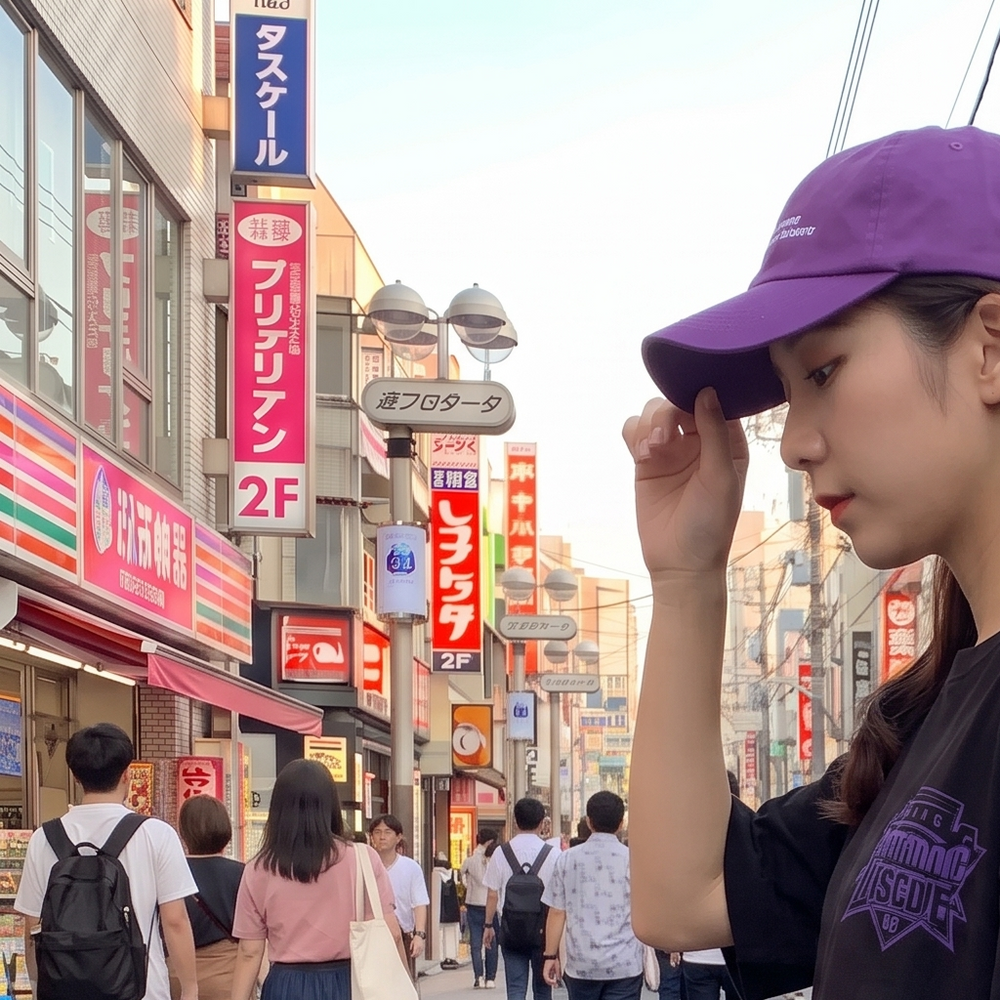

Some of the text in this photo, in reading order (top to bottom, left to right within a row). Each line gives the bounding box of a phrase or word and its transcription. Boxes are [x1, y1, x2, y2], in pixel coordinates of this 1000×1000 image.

[254, 24, 289, 166] タスケール
[238, 475, 299, 518] 2F
[440, 652, 473, 670] 2F
